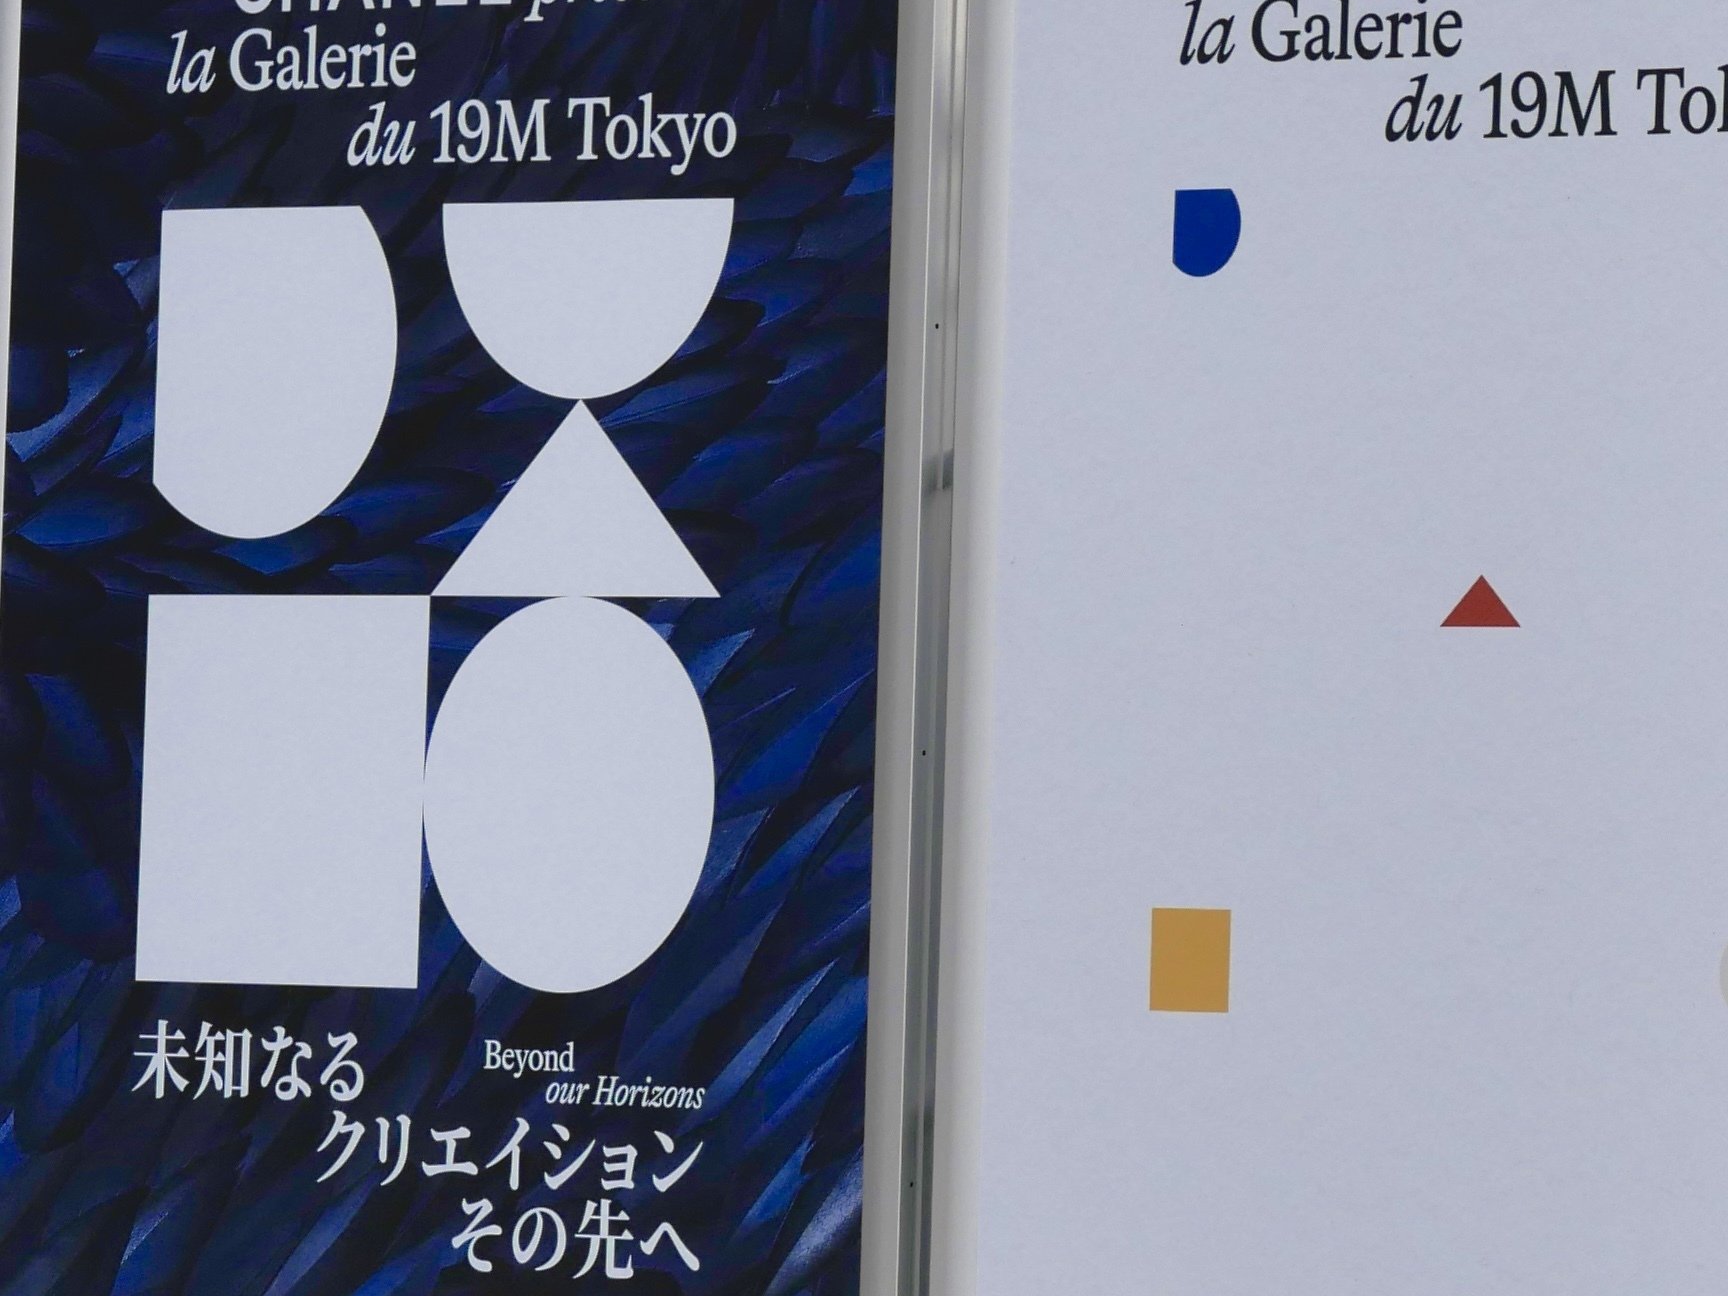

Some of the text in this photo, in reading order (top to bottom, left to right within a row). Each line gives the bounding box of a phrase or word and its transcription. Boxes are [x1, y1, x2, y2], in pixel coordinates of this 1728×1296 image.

[166, 22, 416, 95] la Galerie
[346, 92, 737, 176] du 19M Tokyo
[1384, 72, 1463, 143] du
[1479, 69, 1618, 139] 19M
[132, 1019, 365, 1102] 未知なる
[483, 1039, 575, 1079] Beyond
[546, 1075, 706, 1109] our Horizons
[316, 1110, 704, 1192] クリエイション
[451, 1198, 700, 1280] その先へ
